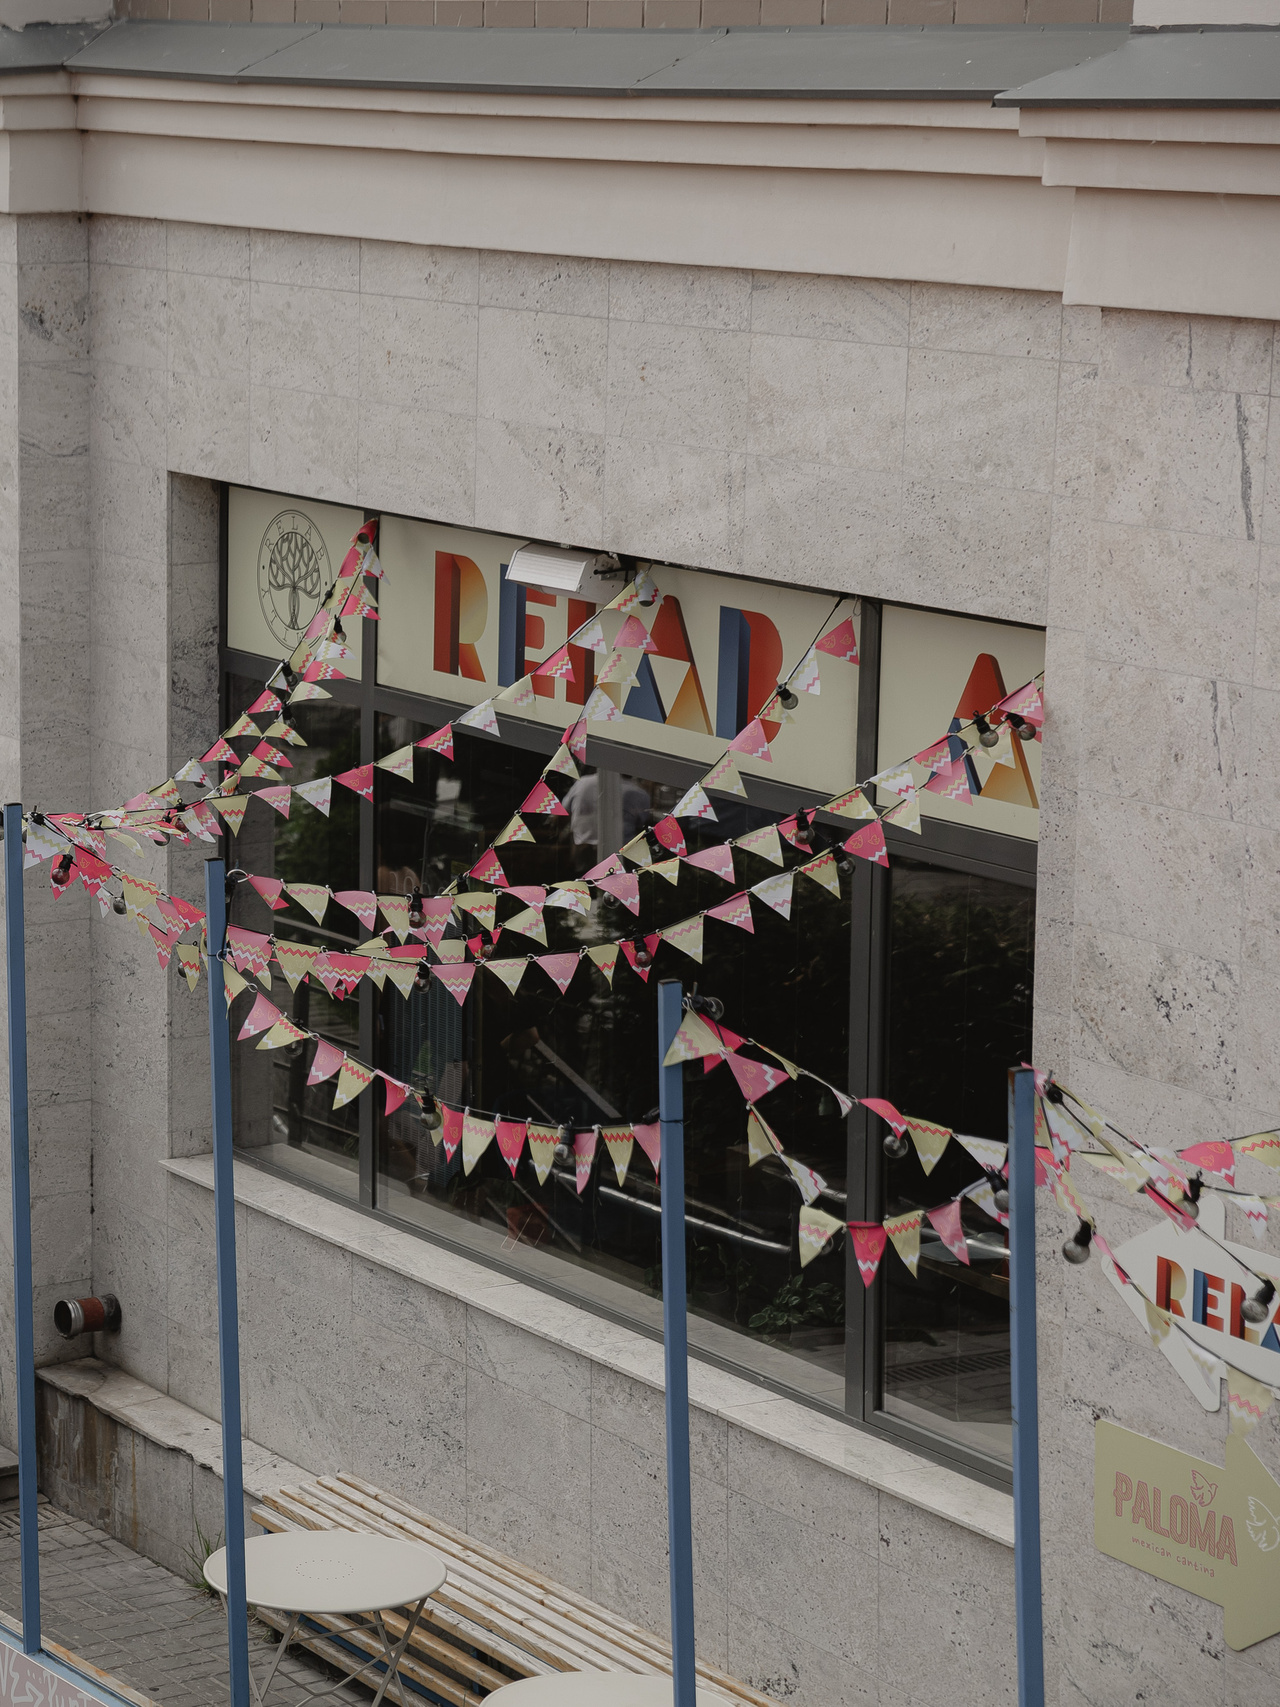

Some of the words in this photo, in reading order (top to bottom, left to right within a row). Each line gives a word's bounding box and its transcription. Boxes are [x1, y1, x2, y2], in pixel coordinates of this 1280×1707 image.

[265, 515, 325, 561] RELAB
[433, 550, 783, 745] RELAB
[1113, 1471, 1238, 1567] PALOMA
[1132, 1536, 1171, 1558] mexican
[1176, 1554, 1215, 1577] cantina
